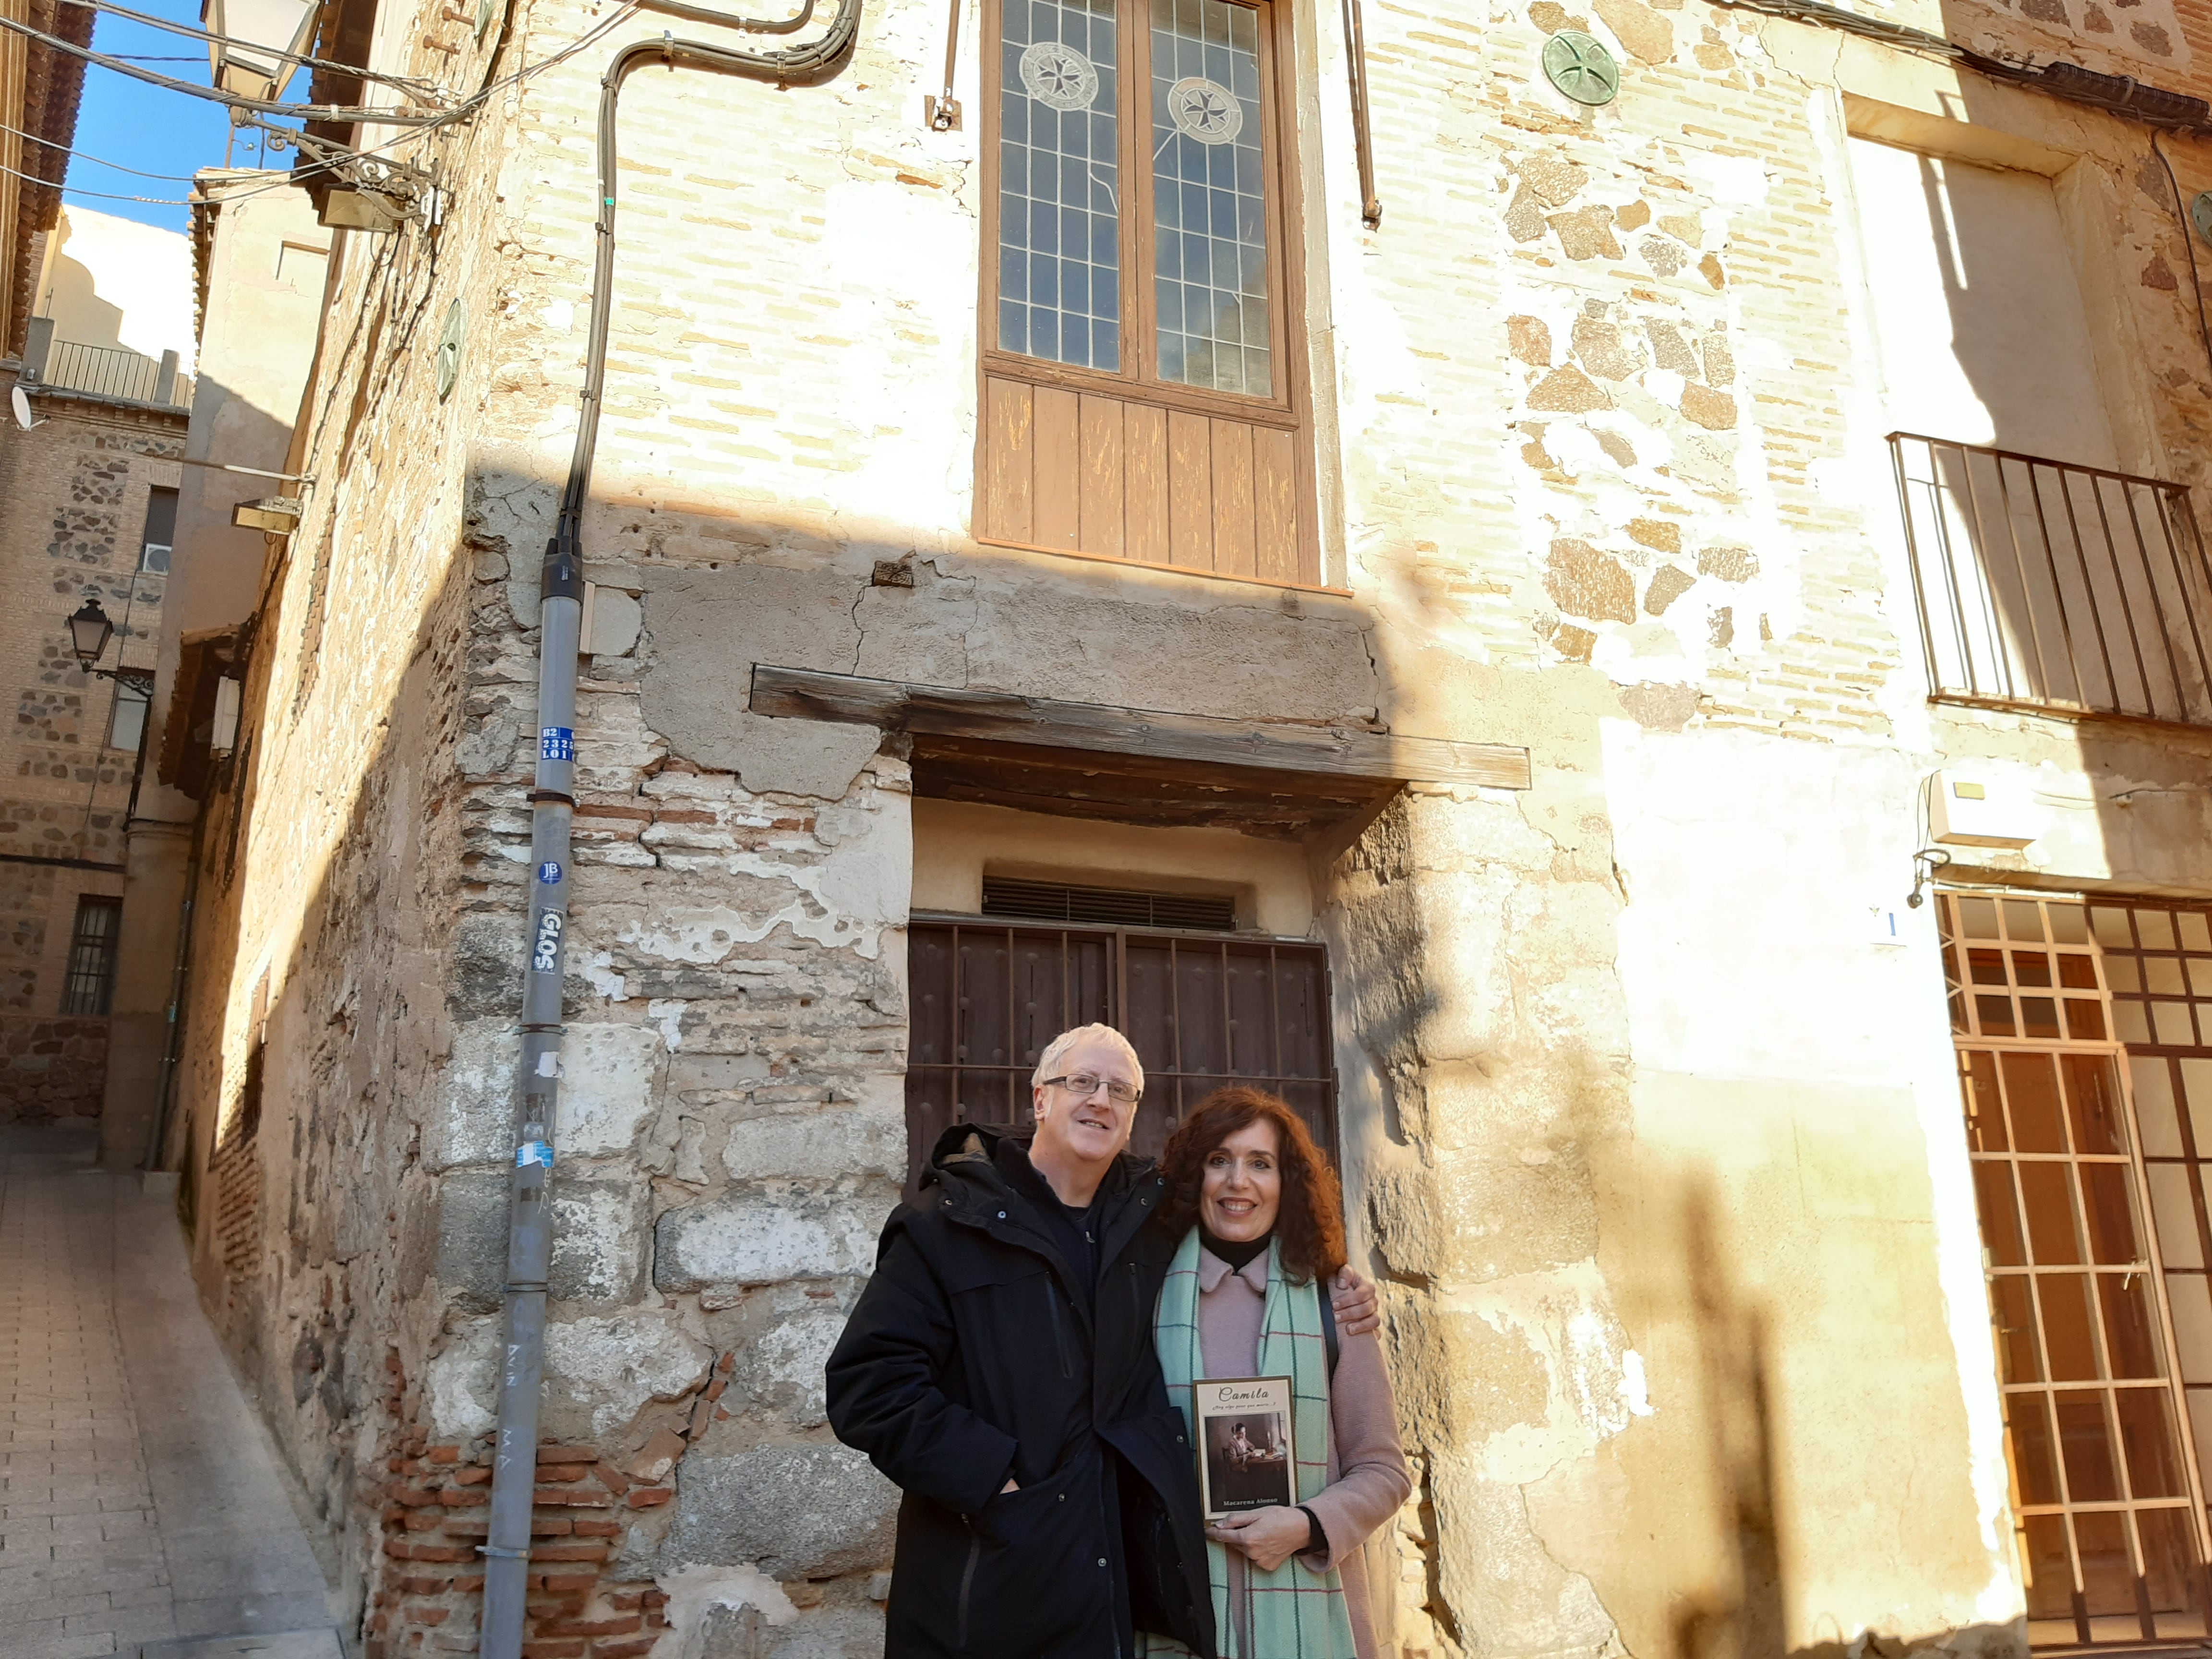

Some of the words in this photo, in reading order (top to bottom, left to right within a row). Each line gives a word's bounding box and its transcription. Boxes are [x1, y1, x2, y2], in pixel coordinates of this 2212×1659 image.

[543, 728, 557, 737] B2
[543, 863, 558, 878] JB
[1219, 1387, 1269, 1402] Camila
